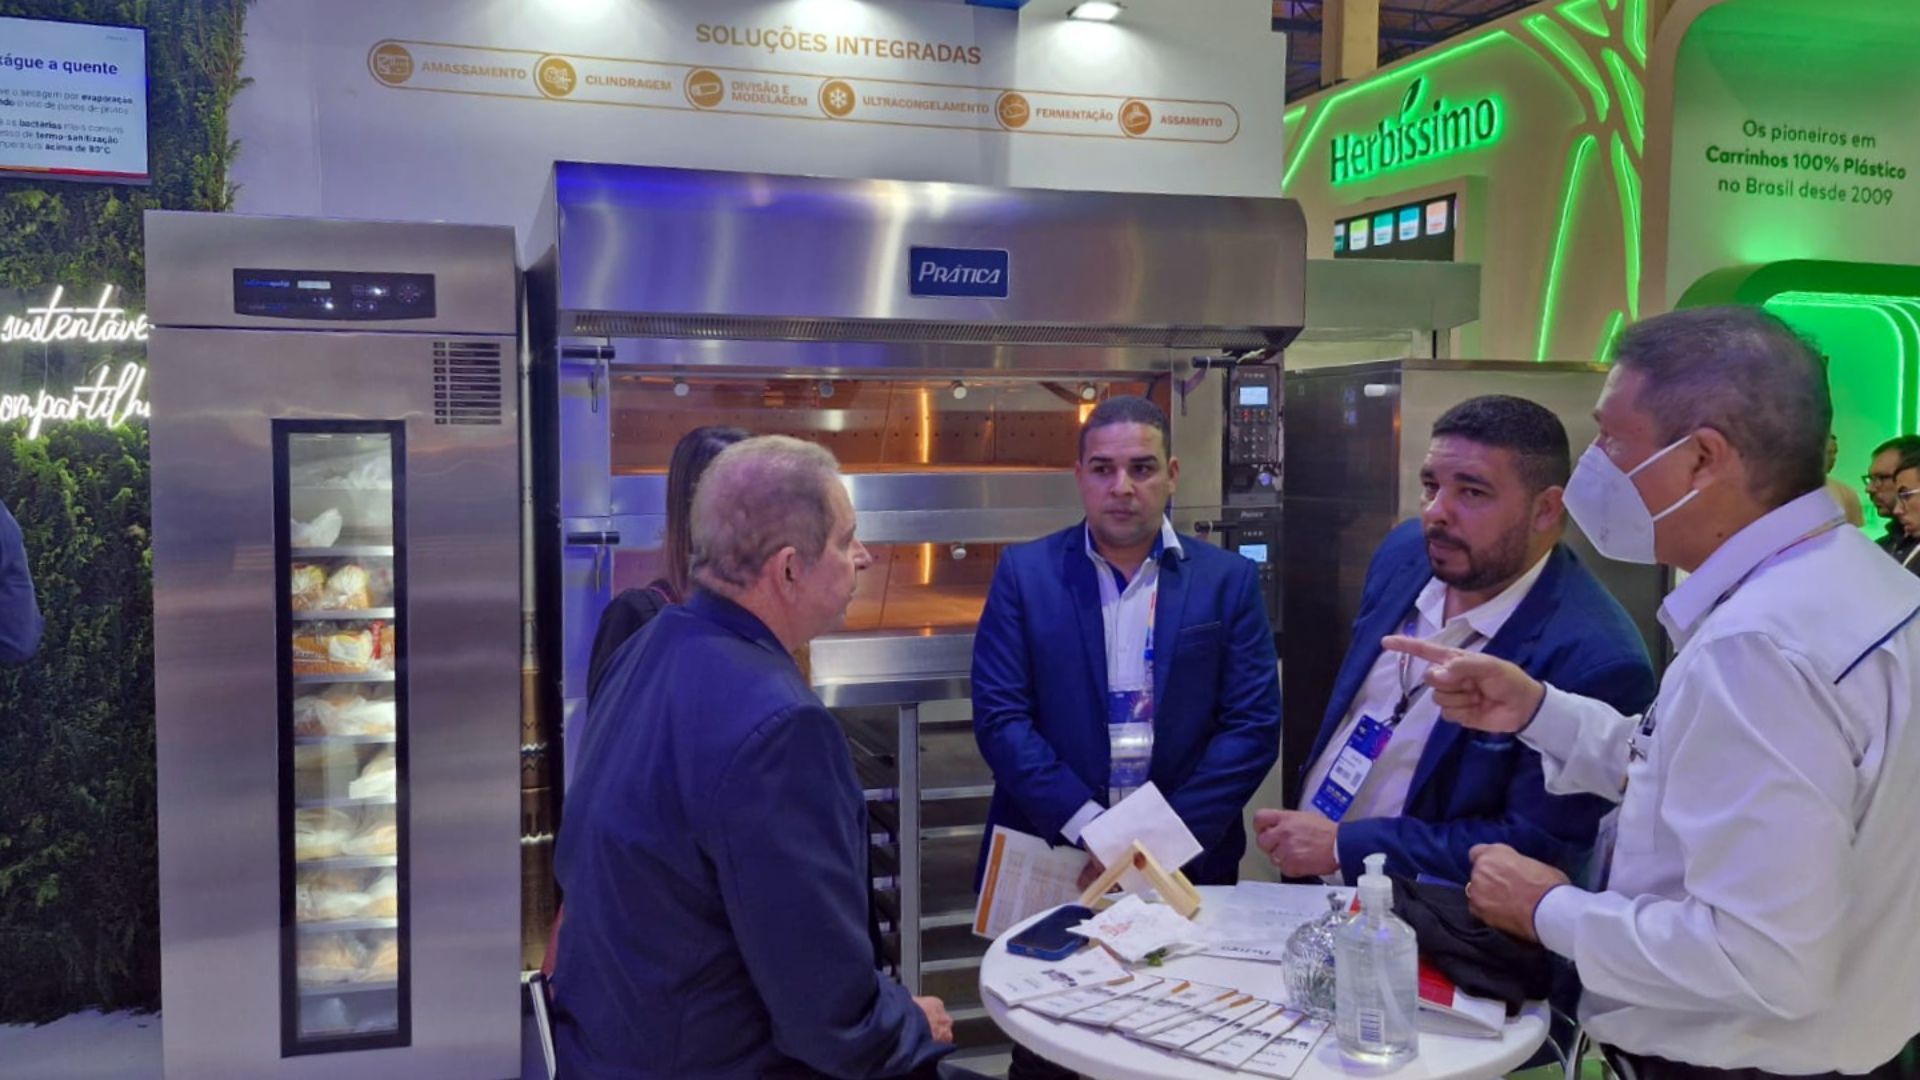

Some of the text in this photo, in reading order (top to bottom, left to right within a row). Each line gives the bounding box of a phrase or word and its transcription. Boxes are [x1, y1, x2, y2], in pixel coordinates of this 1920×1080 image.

[696, 24, 982, 65] SOLUÇÕES INTEGRADAS
[48, 60, 58, 70] a
[62, 61, 118, 75] quente
[421, 61, 527, 80] AMASSAMENTO
[585, 75, 672, 91] CILINDRAGEM
[731, 80, 781, 94] DIVISÃO
[731, 91, 808, 107] MODELAGEM
[862, 96, 990, 114] ULTRACONGELAMENTO
[1036, 107, 1114, 122] FERMENTAÇÃO
[1160, 115, 1223, 128] ASSAMENTO
[1742, 120, 1876, 148] Os pioneiros em
[1705, 145, 1906, 180] Carrinhos 100% Plástico
[1718, 177, 1894, 206] no Brasil desde 2009
